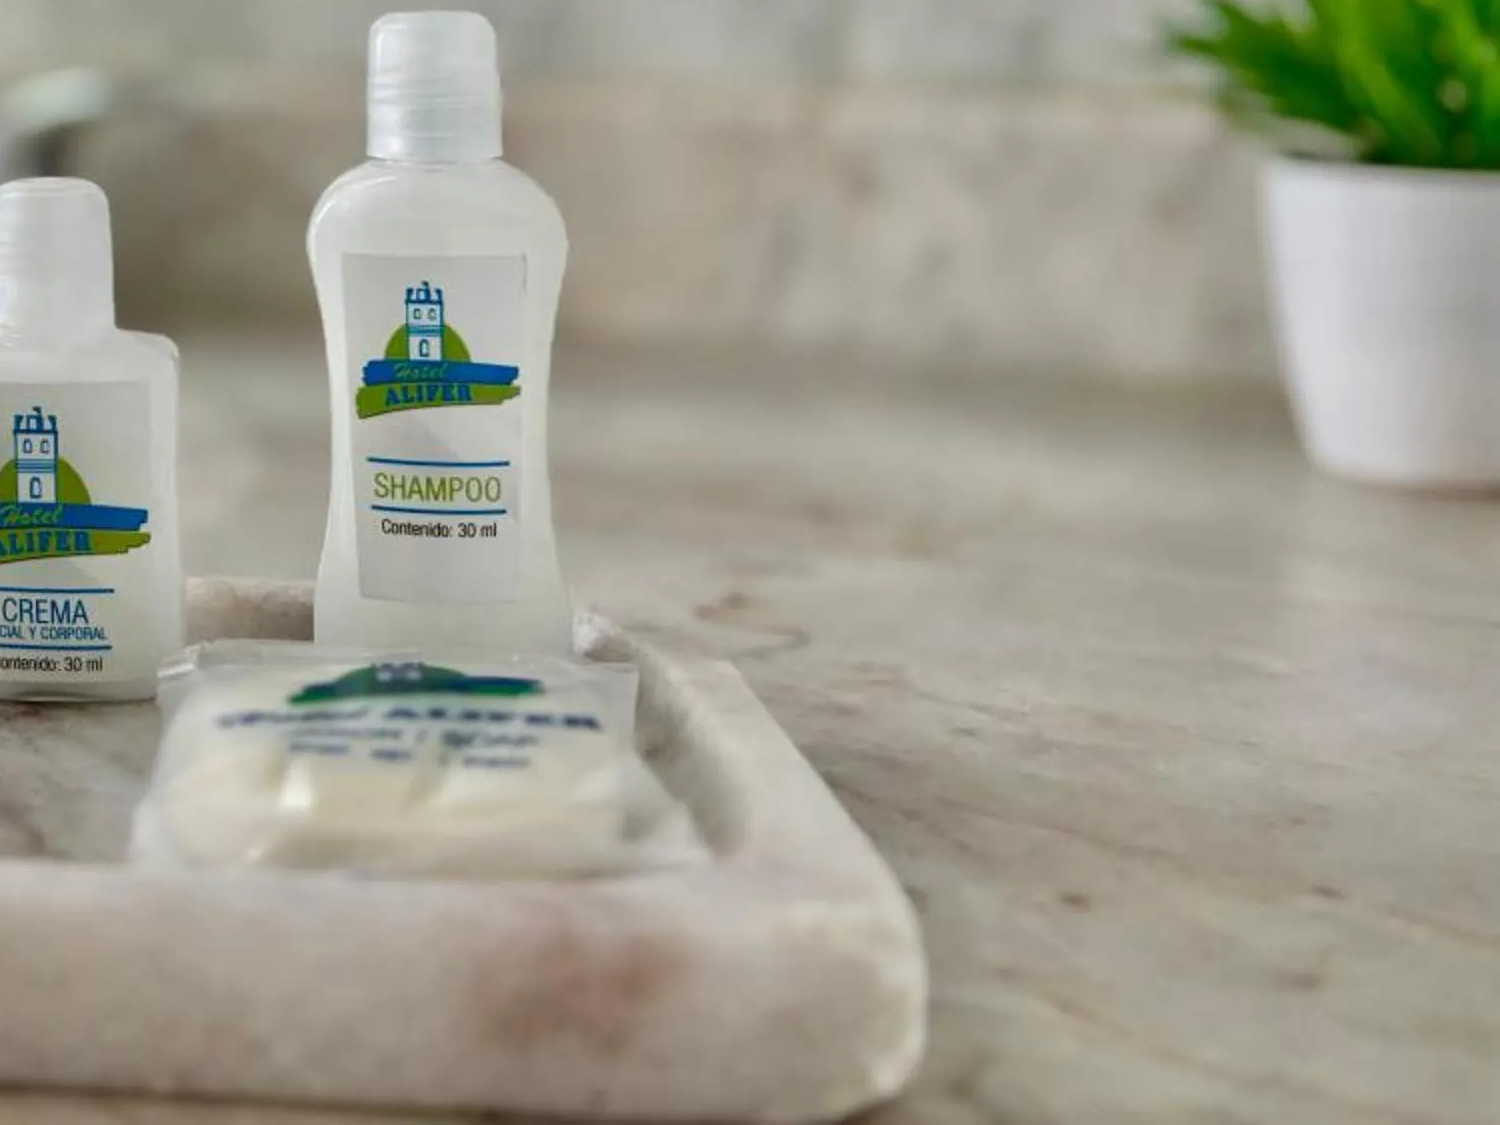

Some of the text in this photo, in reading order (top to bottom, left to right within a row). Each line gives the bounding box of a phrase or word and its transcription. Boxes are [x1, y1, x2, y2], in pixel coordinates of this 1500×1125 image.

[393, 362, 449, 380] Hotel
[384, 382, 473, 407] ALIFER
[373, 471, 501, 503] SHAMPOO
[381, 518, 498, 539] Contenido: 30 ml
[1, 597, 89, 625] CREMA
[28, 625, 37, 640] Y
[40, 625, 108, 641] CORPORAL
[63, 655, 82, 673] 30
[85, 655, 103, 672] ml
